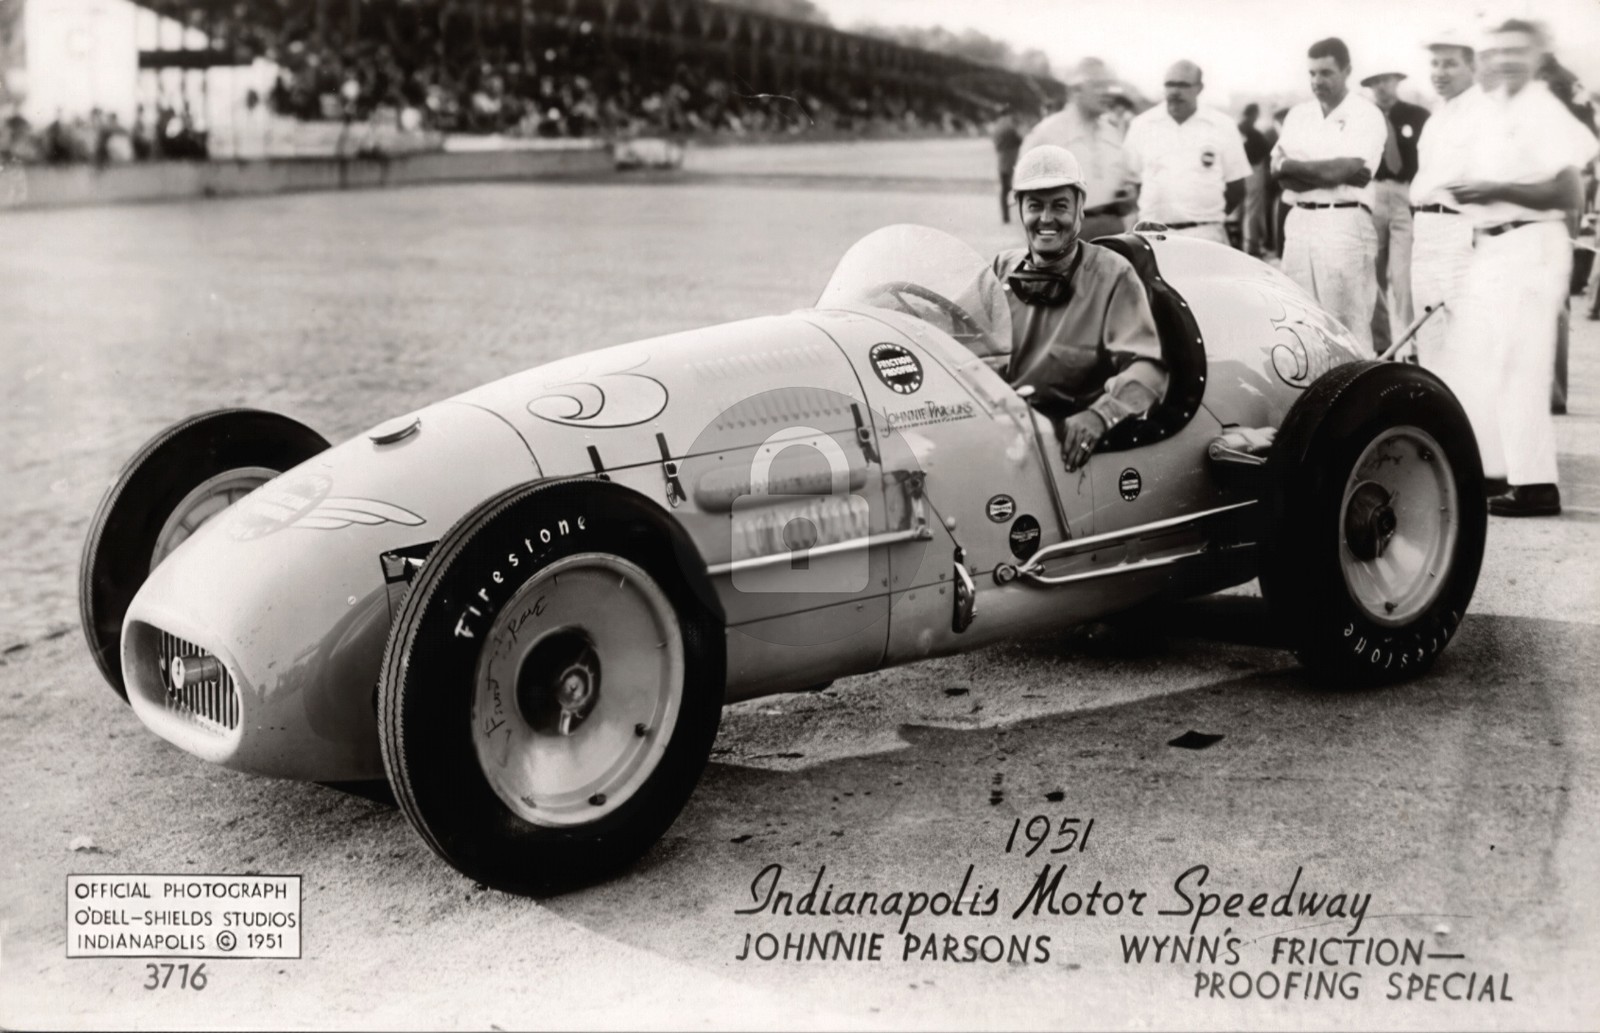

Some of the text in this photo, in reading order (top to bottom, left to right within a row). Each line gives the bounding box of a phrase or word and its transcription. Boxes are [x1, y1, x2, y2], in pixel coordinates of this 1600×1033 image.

[876, 355, 914, 369] FRICTION
[880, 363, 919, 379] PROOFING
[892, 381, 920, 394] OIL
[454, 515, 587, 638] Firestone
